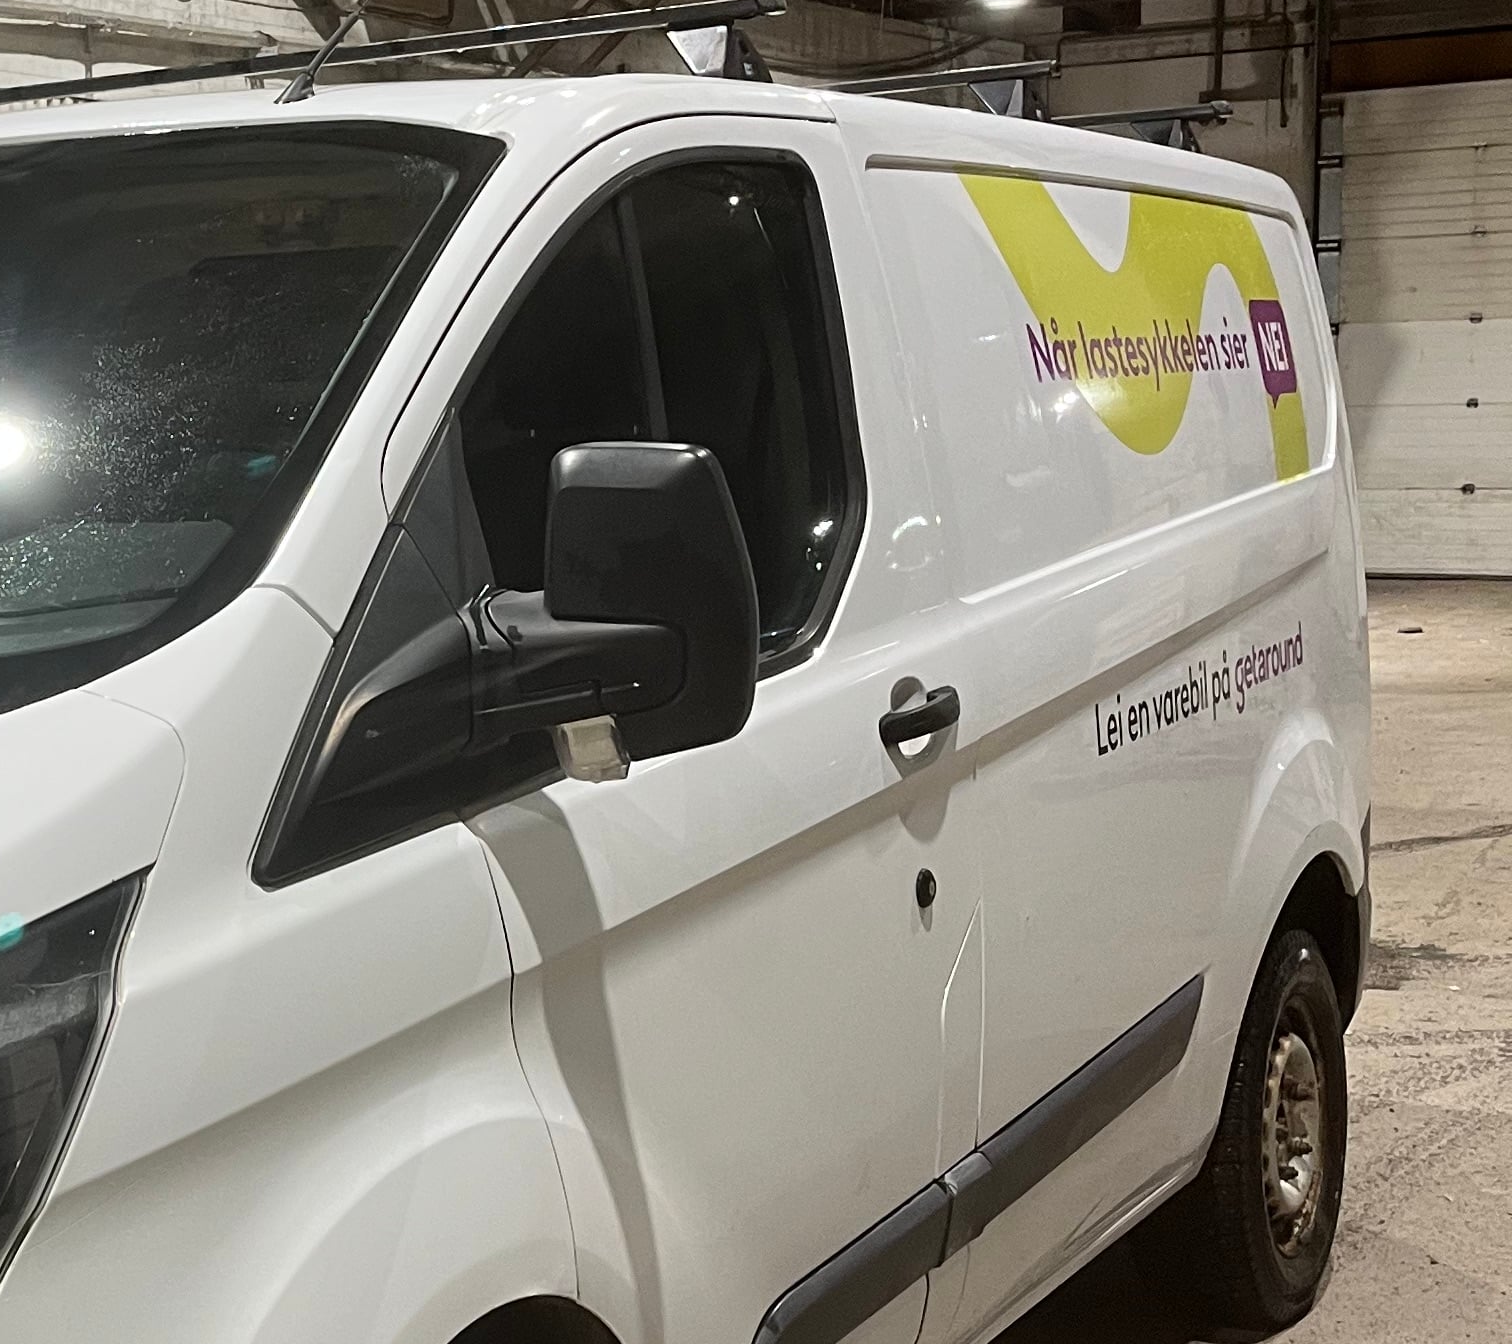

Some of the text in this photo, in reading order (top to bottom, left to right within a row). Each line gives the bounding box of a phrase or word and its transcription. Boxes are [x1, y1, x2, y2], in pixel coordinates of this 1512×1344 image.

[1026, 316, 1290, 392] Når lastesykkelen sier NEI
[1095, 620, 1304, 756] Lei en varebil på getaround
